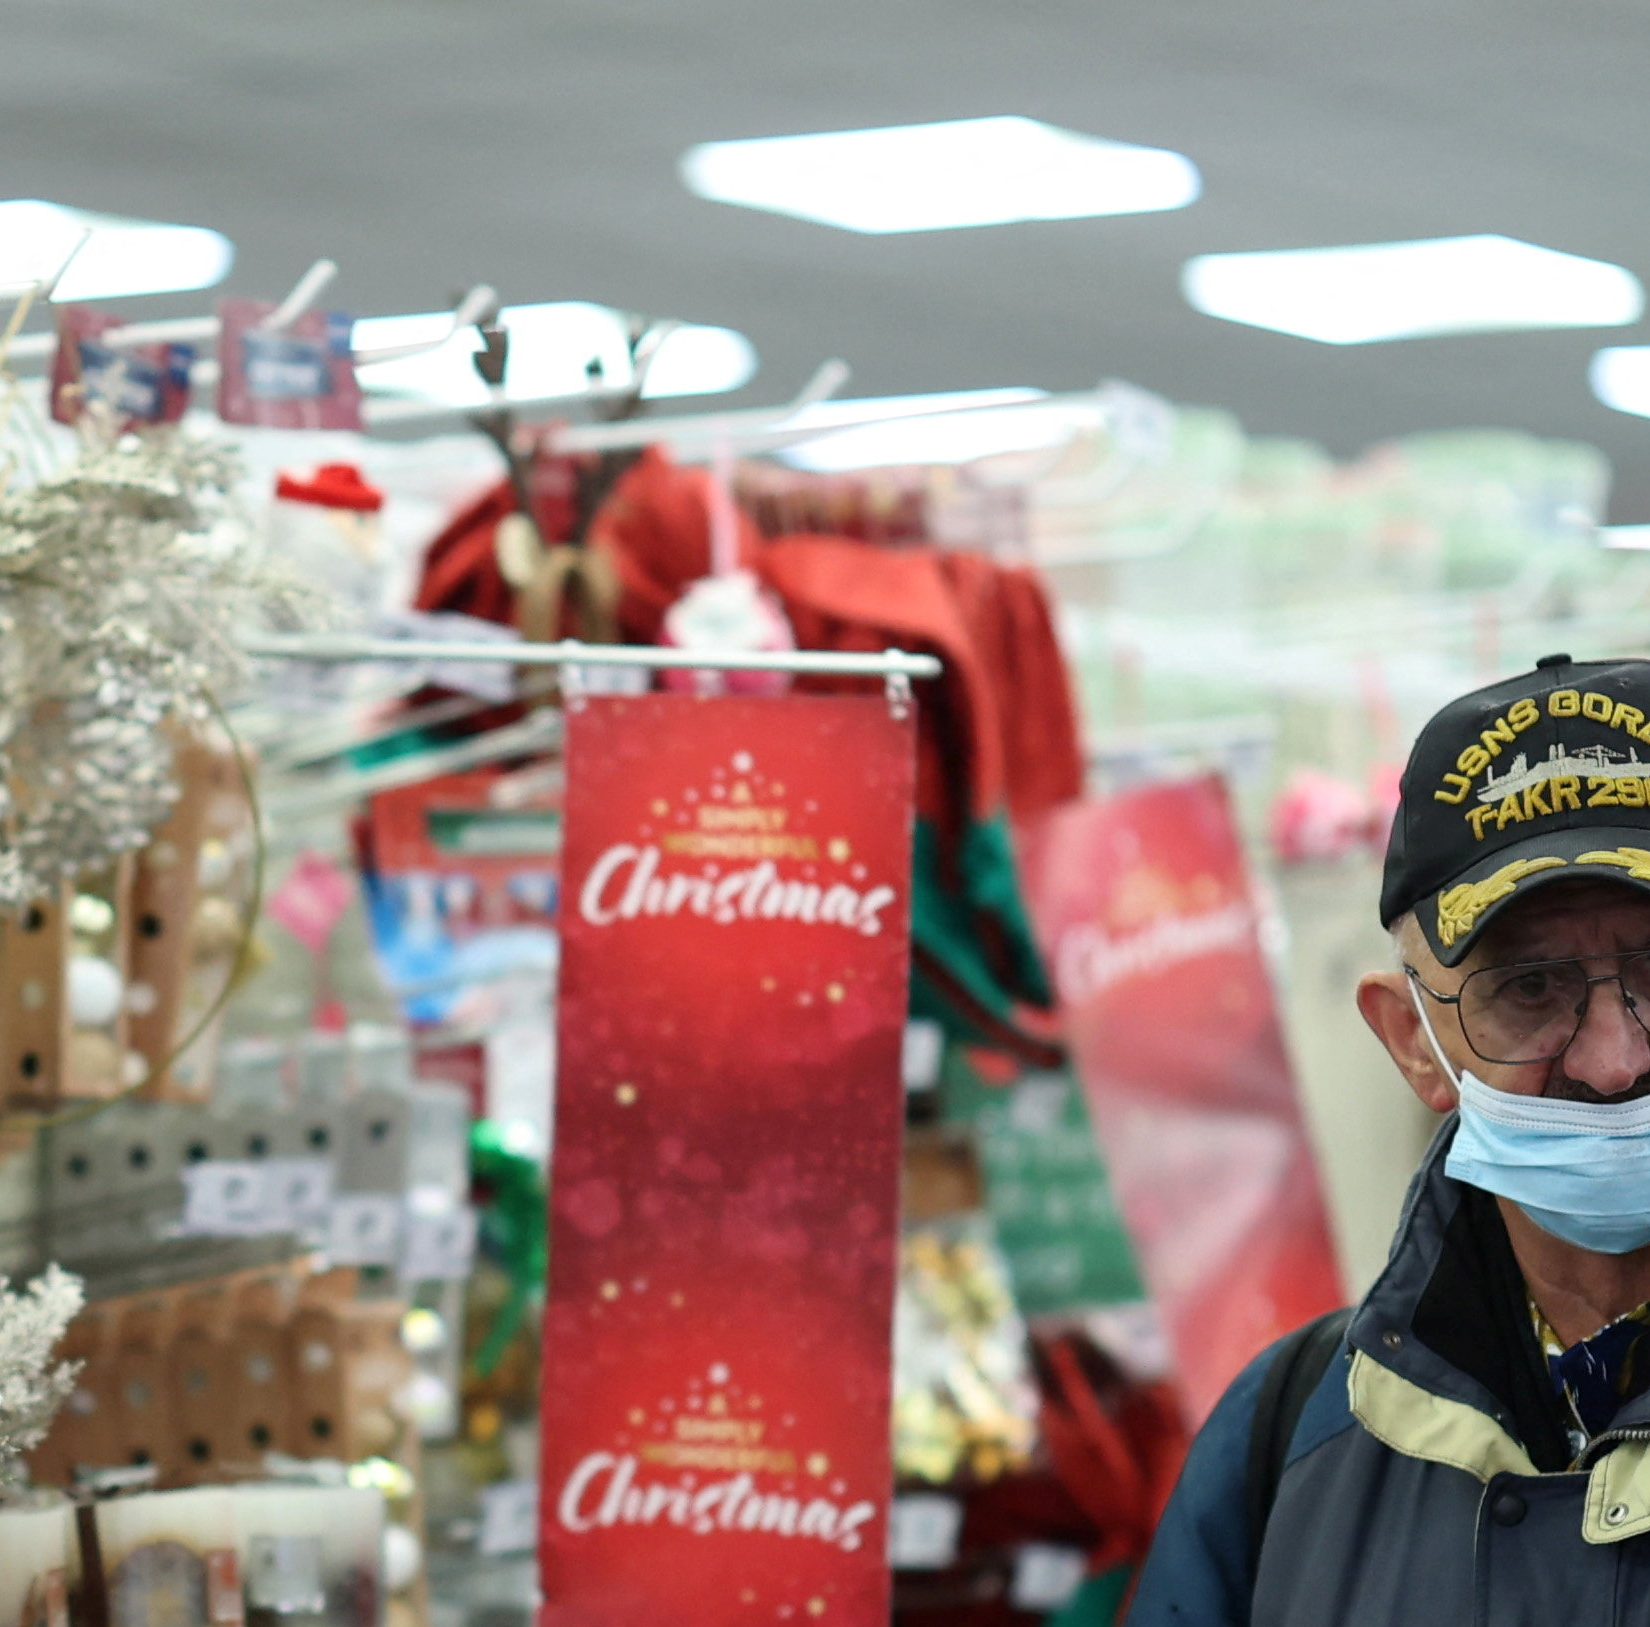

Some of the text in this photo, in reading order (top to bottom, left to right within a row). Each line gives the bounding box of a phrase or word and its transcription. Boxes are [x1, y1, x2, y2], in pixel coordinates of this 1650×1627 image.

[1433, 697, 1541, 806] USNS
[1465, 777, 1582, 842] T-AKR
[578, 843, 897, 938] Christmas
[557, 1450, 876, 1552] Christmas
